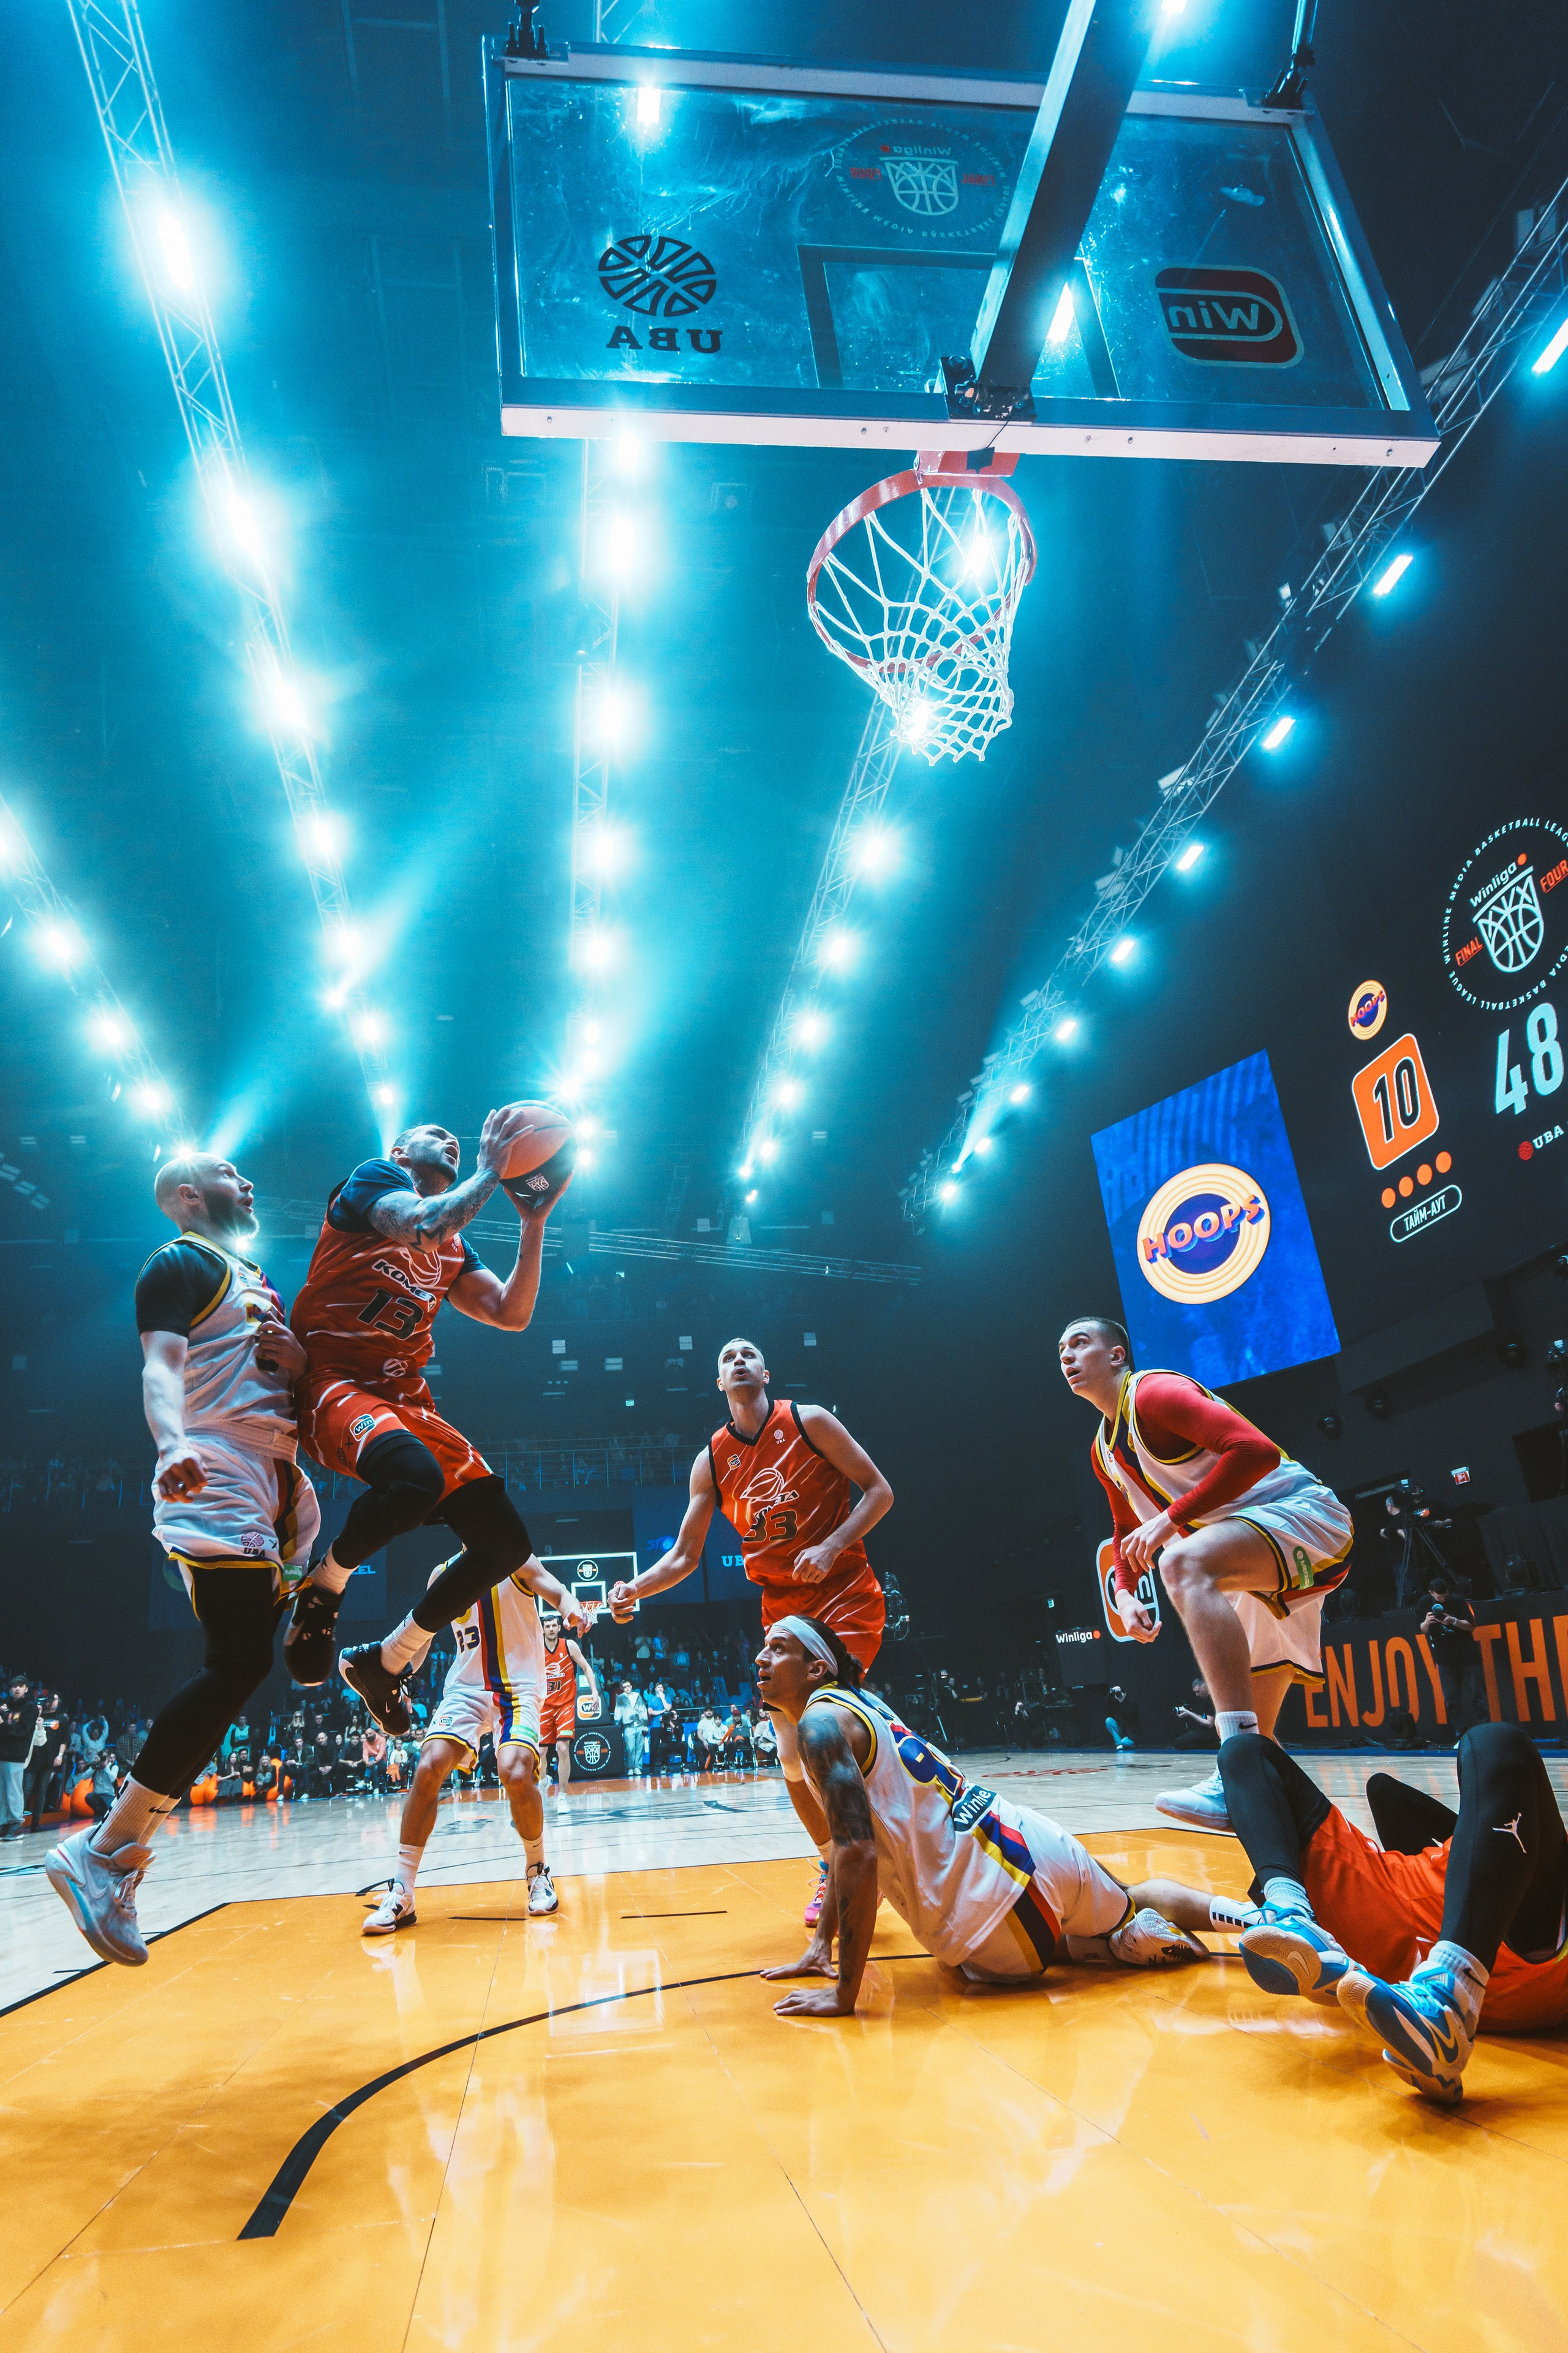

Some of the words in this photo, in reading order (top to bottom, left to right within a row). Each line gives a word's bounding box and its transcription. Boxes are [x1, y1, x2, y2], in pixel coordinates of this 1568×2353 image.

[1442, 907, 1452, 965] WINLINE
[1449, 859, 1473, 901] MEDIA
[1474, 817, 1540, 856] BASKETBALL
[1544, 820, 1568, 848] LEAG
[1469, 861, 1518, 908] Winliga
[1455, 936, 1483, 967] FINAL
[1540, 859, 1568, 894] FOUR
[1548, 945, 1568, 976] DIA
[1449, 970, 1477, 1005] LEAGUE
[1480, 980, 1547, 1011] BASKETBALL
[1350, 989, 1386, 1027] HOOPS
[1495, 1002, 1565, 1116] 48
[1373, 1055, 1422, 1145] 10
[1532, 1125, 1564, 1149] UBA
[1142, 1194, 1266, 1264] HOOPS
[1403, 1195, 1446, 1233] ТАЙМ-АУТ
[356, 1288, 424, 1341] 13
[244, 1547, 266, 1557] UBA
[722, 1555, 744, 1567] UB
[1055, 1631, 1093, 1644] Winliga
[1303, 1633, 1448, 1728] ENJOY
